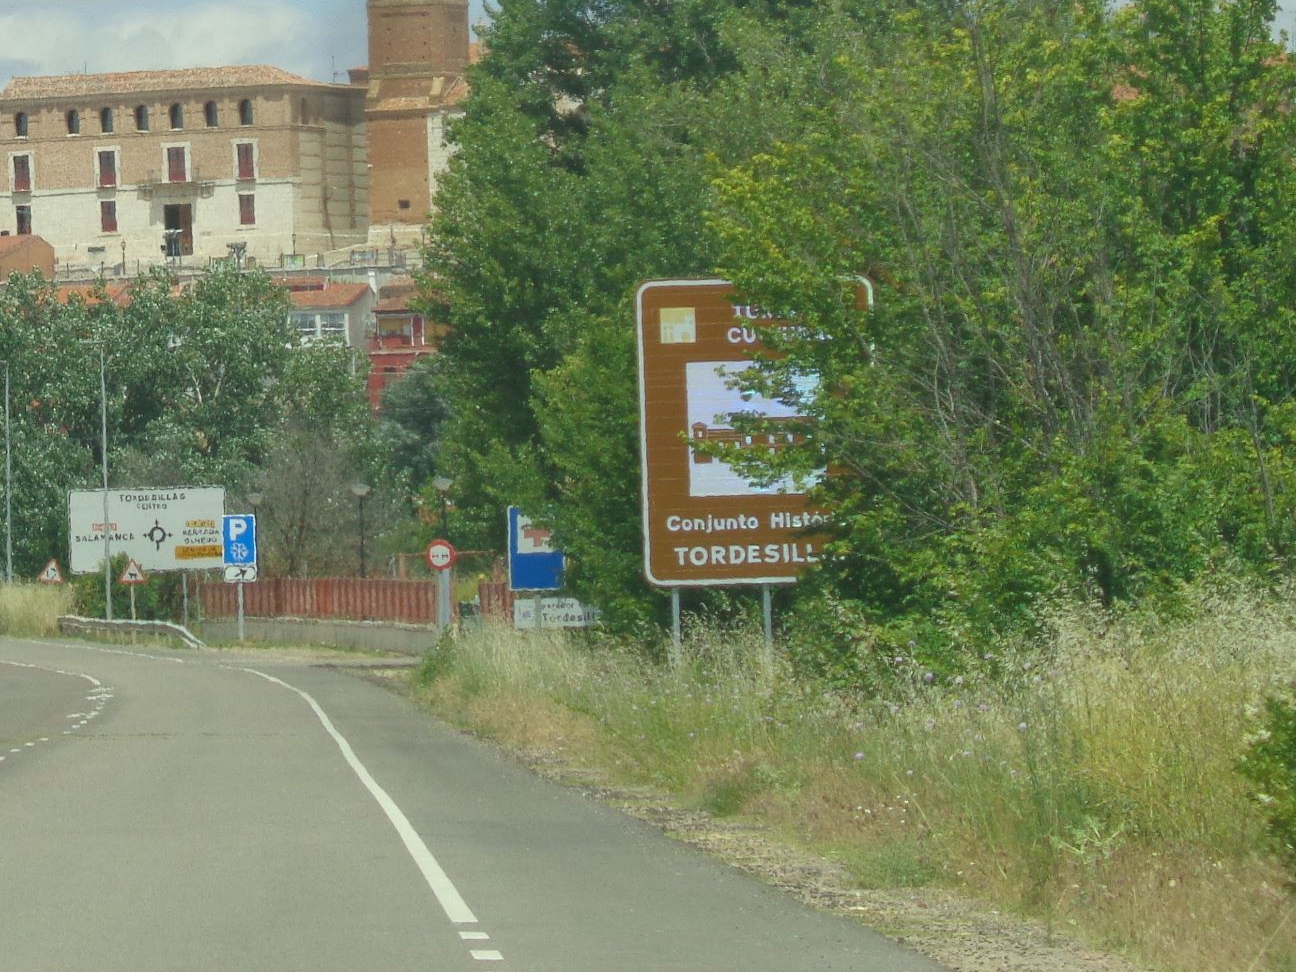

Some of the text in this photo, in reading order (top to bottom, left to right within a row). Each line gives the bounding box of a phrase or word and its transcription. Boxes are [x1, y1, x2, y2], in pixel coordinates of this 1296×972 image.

[119, 492, 186, 503] TORDESILLAS
[229, 518, 247, 541] P
[666, 514, 760, 533] Conjunto
[673, 543, 822, 566] TORDESILL
